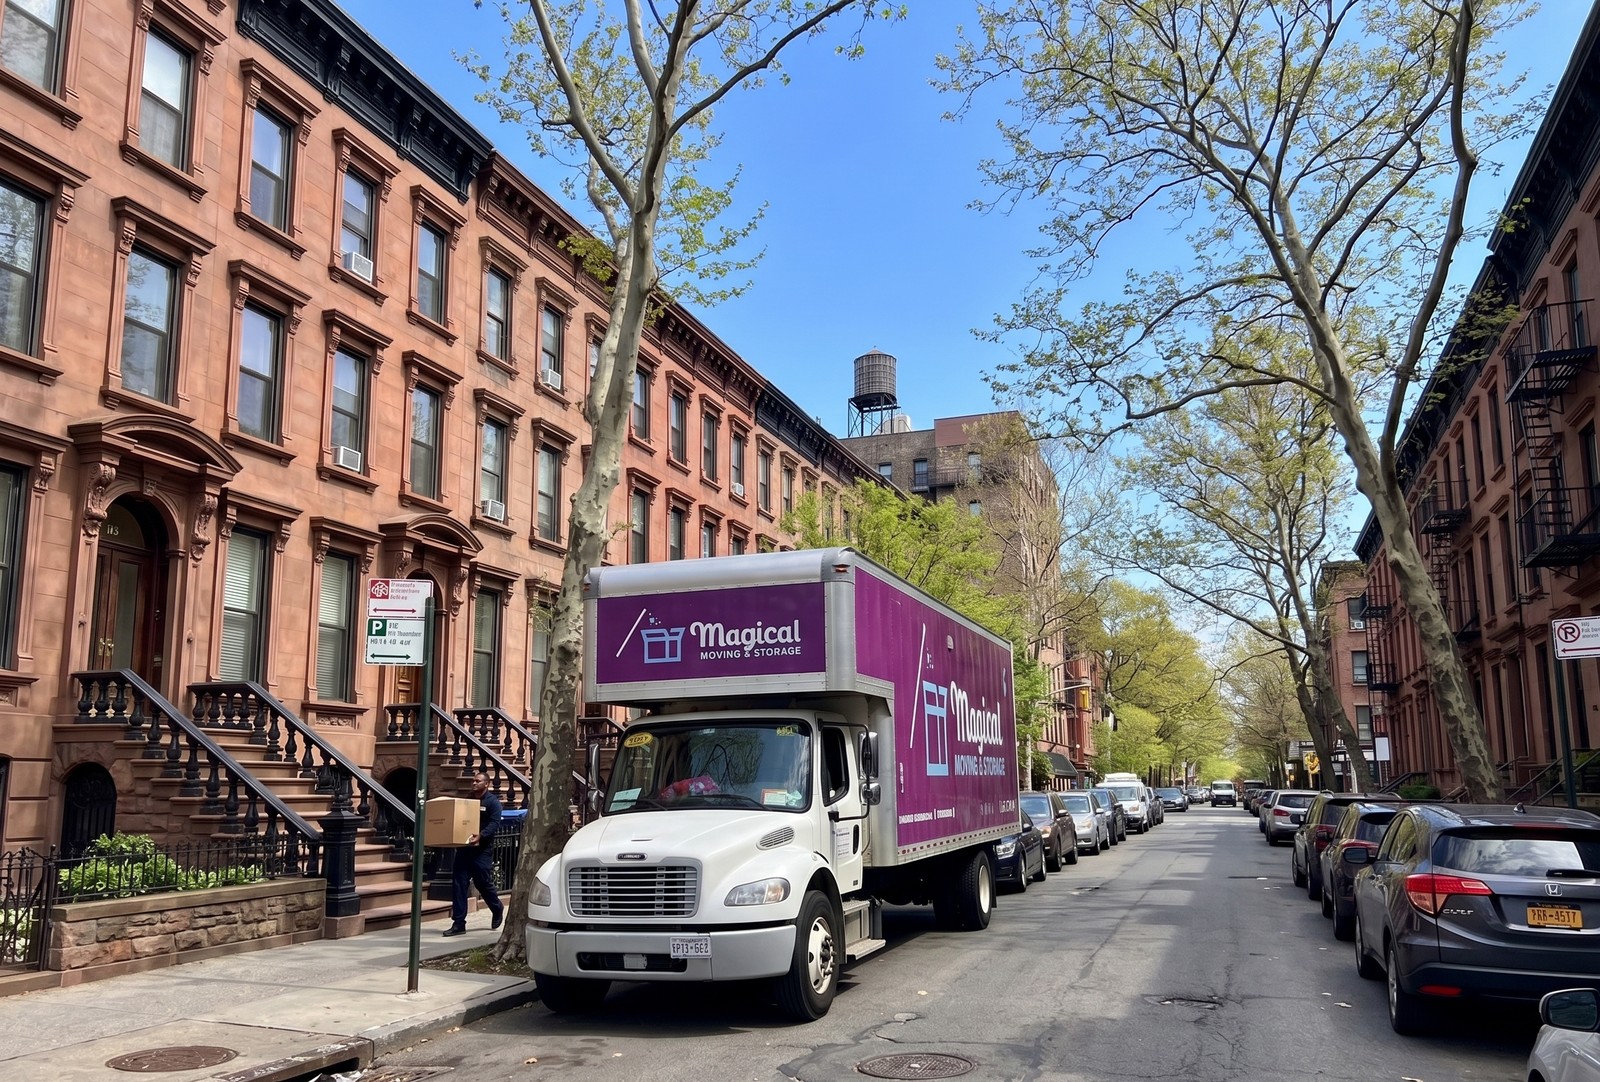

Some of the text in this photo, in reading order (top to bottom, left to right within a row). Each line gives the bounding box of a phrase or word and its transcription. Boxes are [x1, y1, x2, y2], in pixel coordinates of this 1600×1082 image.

[372, 620, 383, 634] P
[690, 619, 801, 651] Magical
[700, 650, 741, 660] MOVING
[754, 646, 801, 657] STORAGE
[950, 680, 1003, 755] Magical
